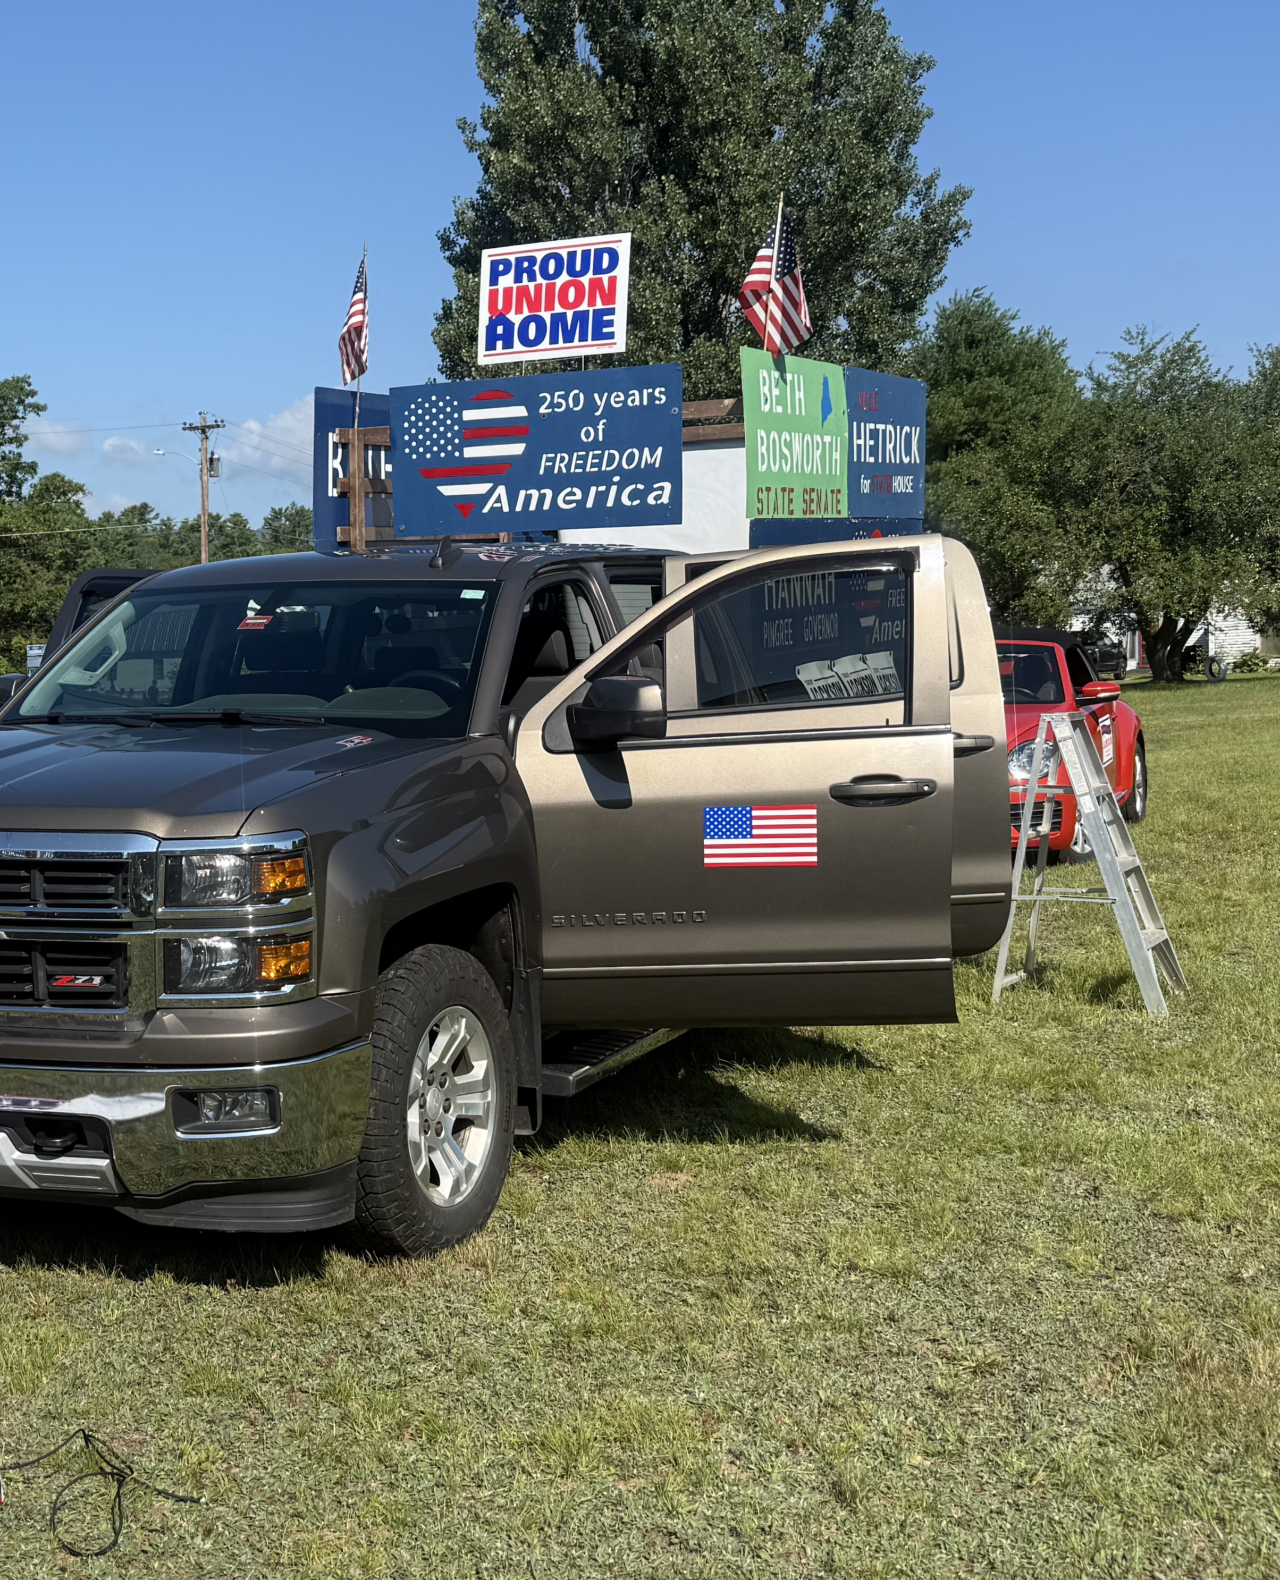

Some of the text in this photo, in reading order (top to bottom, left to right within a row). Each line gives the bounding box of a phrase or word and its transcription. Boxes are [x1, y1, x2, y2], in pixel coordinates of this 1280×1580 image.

[489, 247, 619, 286] PROUD
[488, 276, 617, 317] UNION
[539, 387, 667, 416] 250 years
[759, 369, 805, 416] BETH
[581, 419, 606, 442] of
[853, 421, 920, 464] HETRICK
[539, 446, 663, 475] FREEDOM
[757, 429, 841, 475] BOSWORTH
[482, 476, 672, 513] America
[756, 487, 841, 516] STATE SENATE
[860, 474, 870, 493] for
[765, 572, 835, 610] HANNAH
[763, 612, 839, 648] PINGREE GOVERNOR
[551, 910, 707, 928] SILVERADO
[52, 975, 103, 987] Z71
